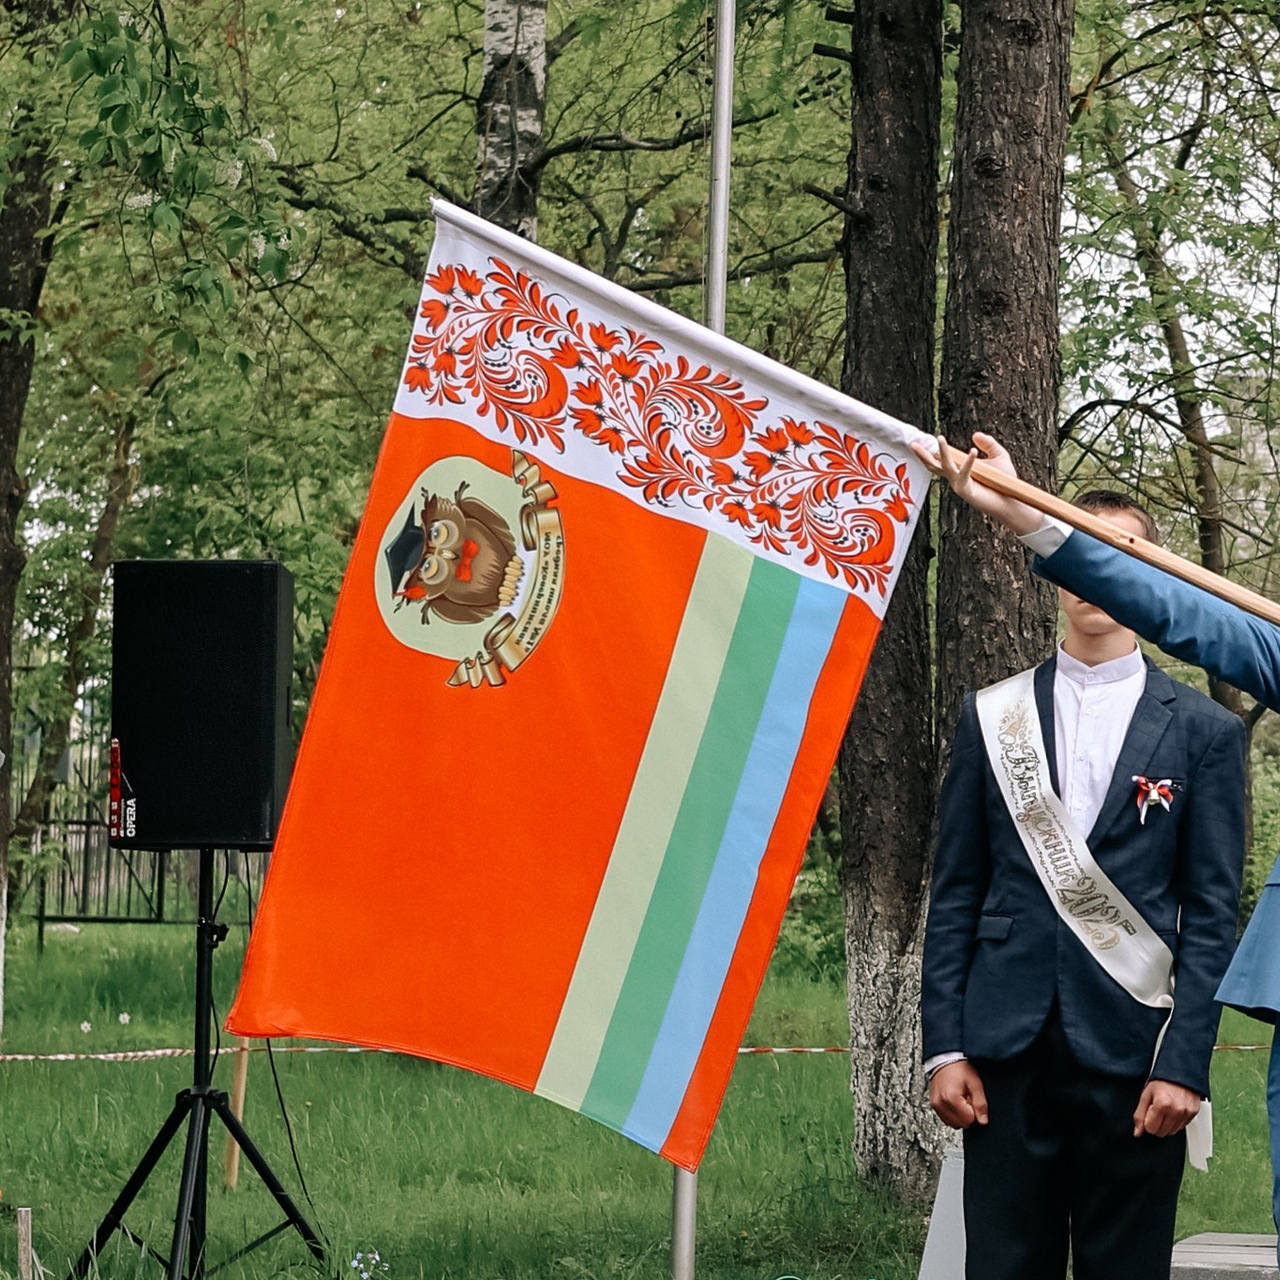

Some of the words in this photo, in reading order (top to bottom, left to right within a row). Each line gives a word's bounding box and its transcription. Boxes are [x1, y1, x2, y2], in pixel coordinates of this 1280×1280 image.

[126, 798, 137, 837] OPERA
[1005, 745, 1079, 887] Выпускник
[1056, 876, 1137, 951] 2025
